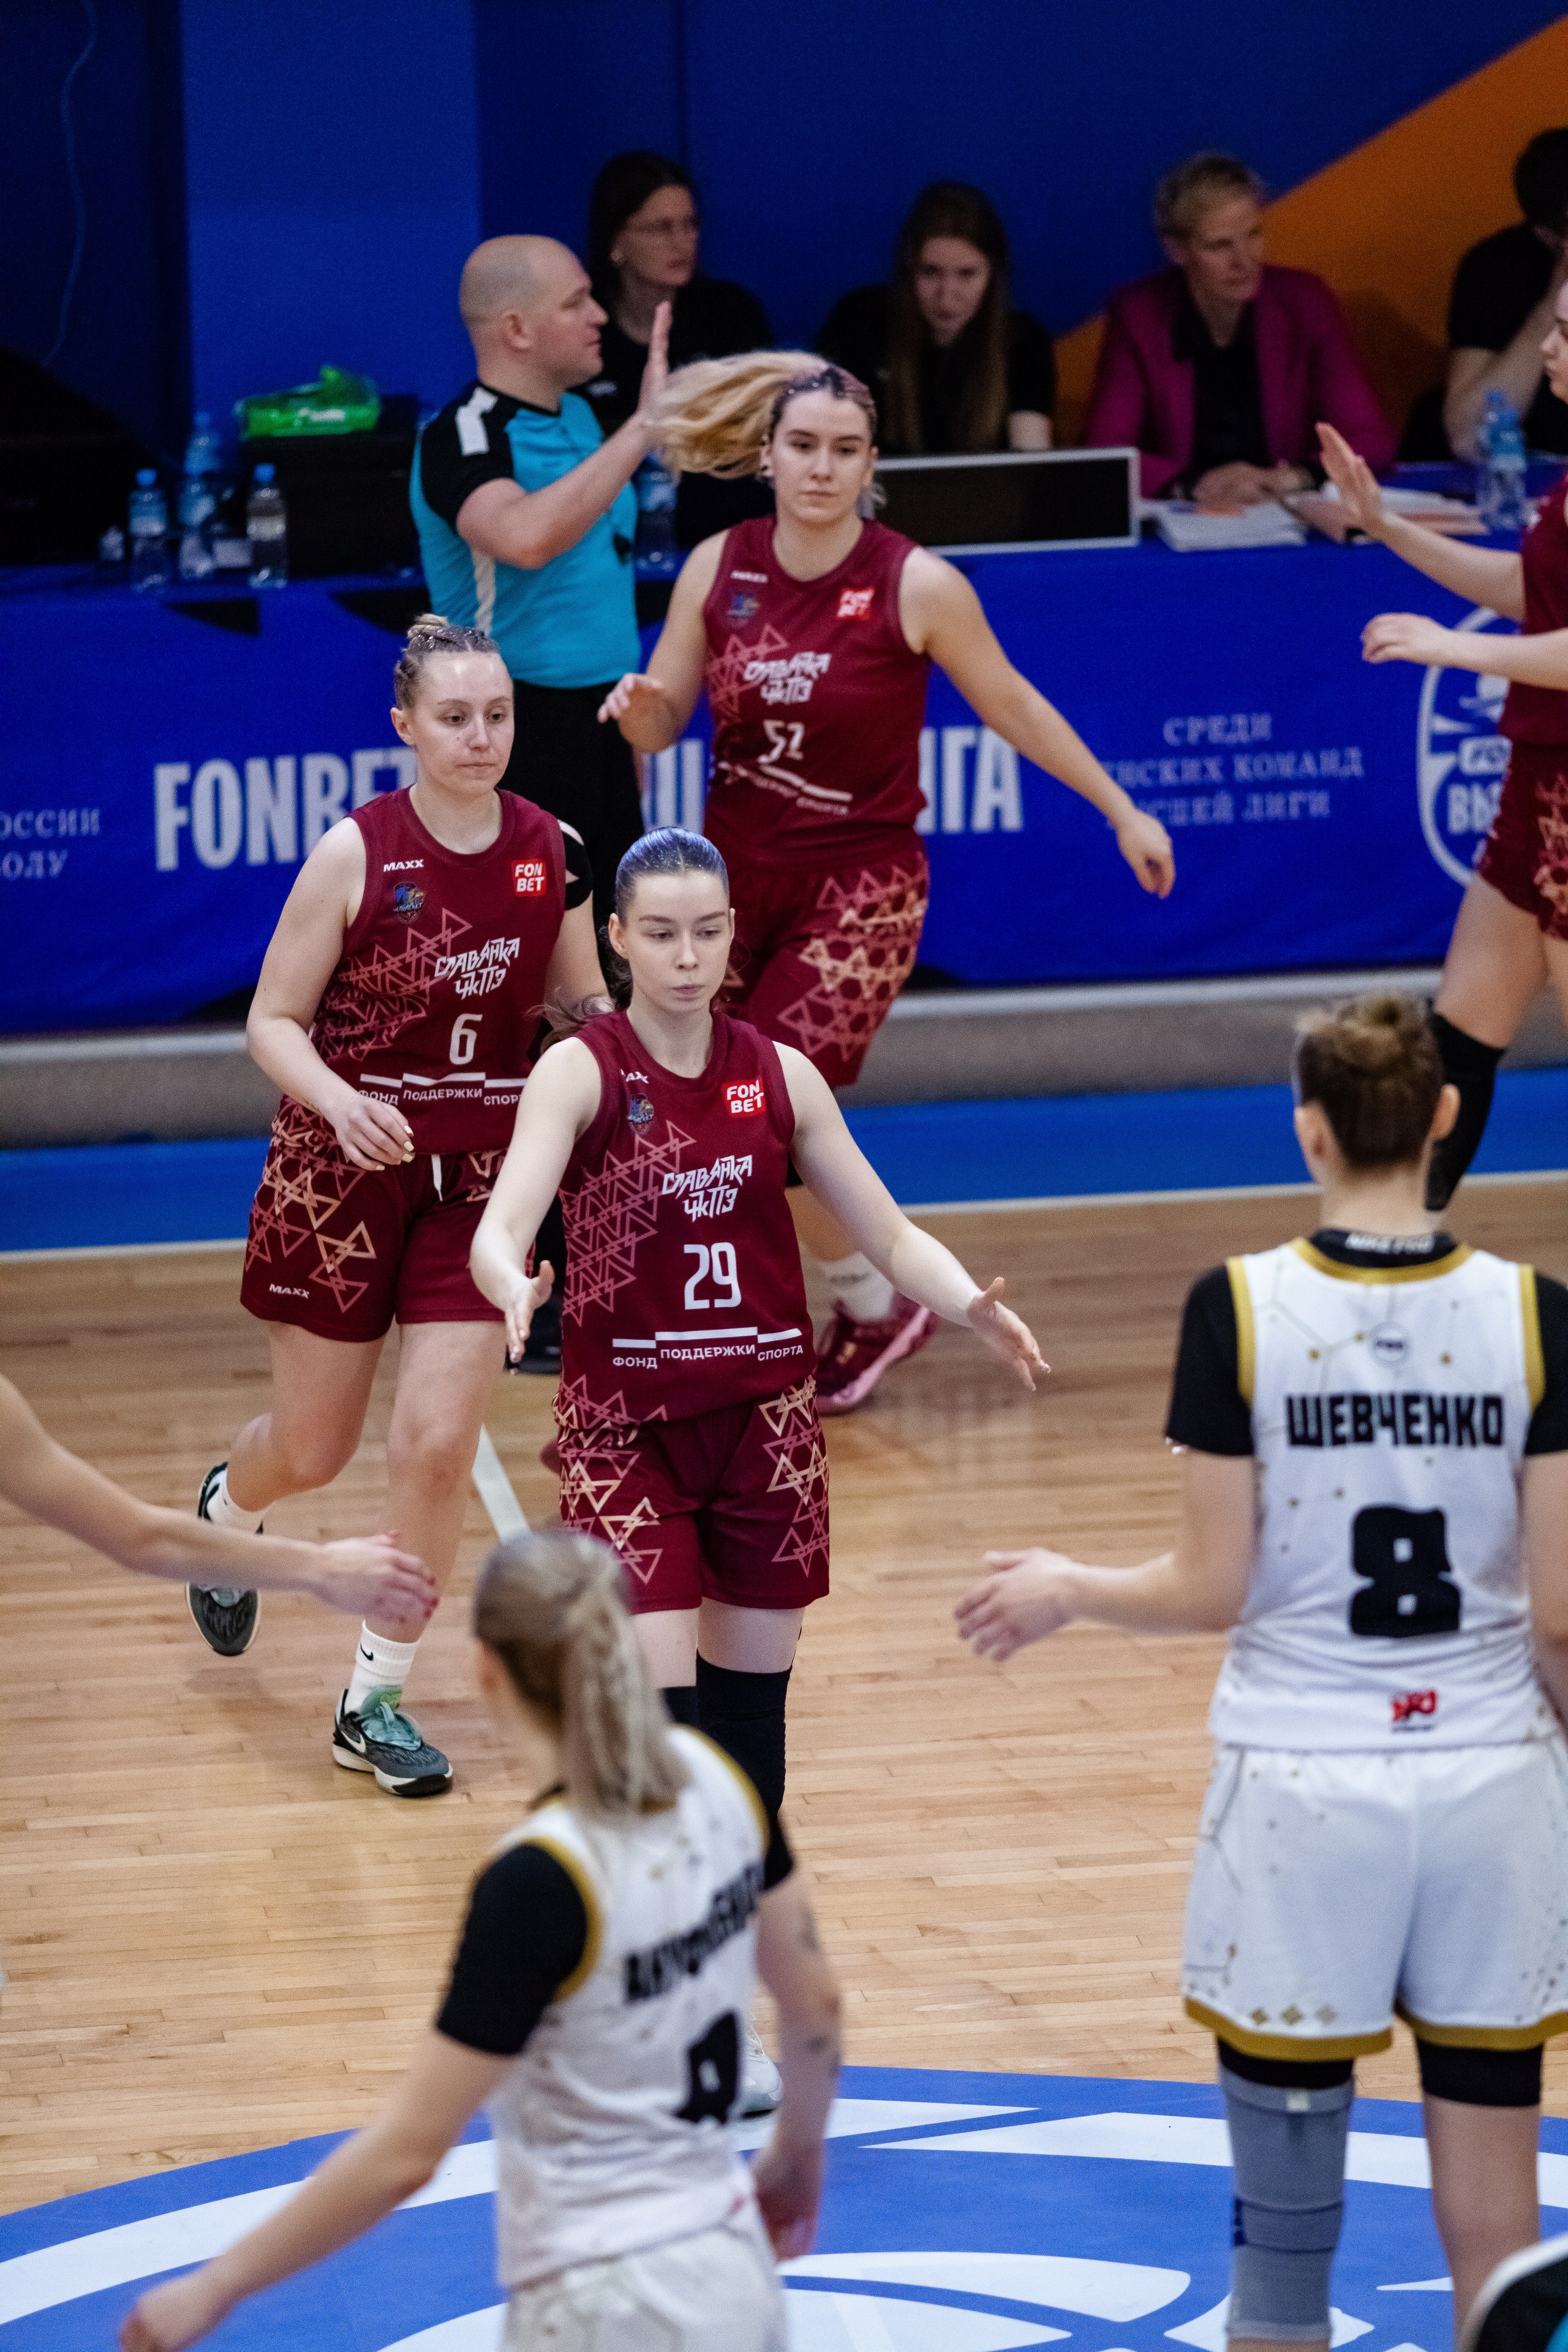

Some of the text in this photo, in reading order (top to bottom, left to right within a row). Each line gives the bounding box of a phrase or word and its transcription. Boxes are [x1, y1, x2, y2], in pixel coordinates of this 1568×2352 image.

[1164, 712, 1272, 747] СРЕДИ
[1232, 745, 1365, 784] КОМАНД
[1242, 790, 1331, 823] ЛИГИ
[383, 859, 424, 872] MAXX
[515, 862, 543, 877] FON
[516, 876, 545, 892] BET
[449, 1013, 483, 1065] 6
[403, 1088, 483, 1101] ПОДДЕРЖКИ
[484, 1094, 521, 1106] СПОР
[726, 1079, 760, 1101] FON
[731, 1092, 764, 1114] BET
[683, 1242, 742, 1310] 29
[269, 1284, 310, 1299] MAXX
[612, 1344, 804, 1369] ФОНД ПОДДЕРЖКИ СПОРТА
[1286, 1392, 1505, 1447] ШЕВЧЕНКО
[1350, 1504, 1461, 1637] 8
